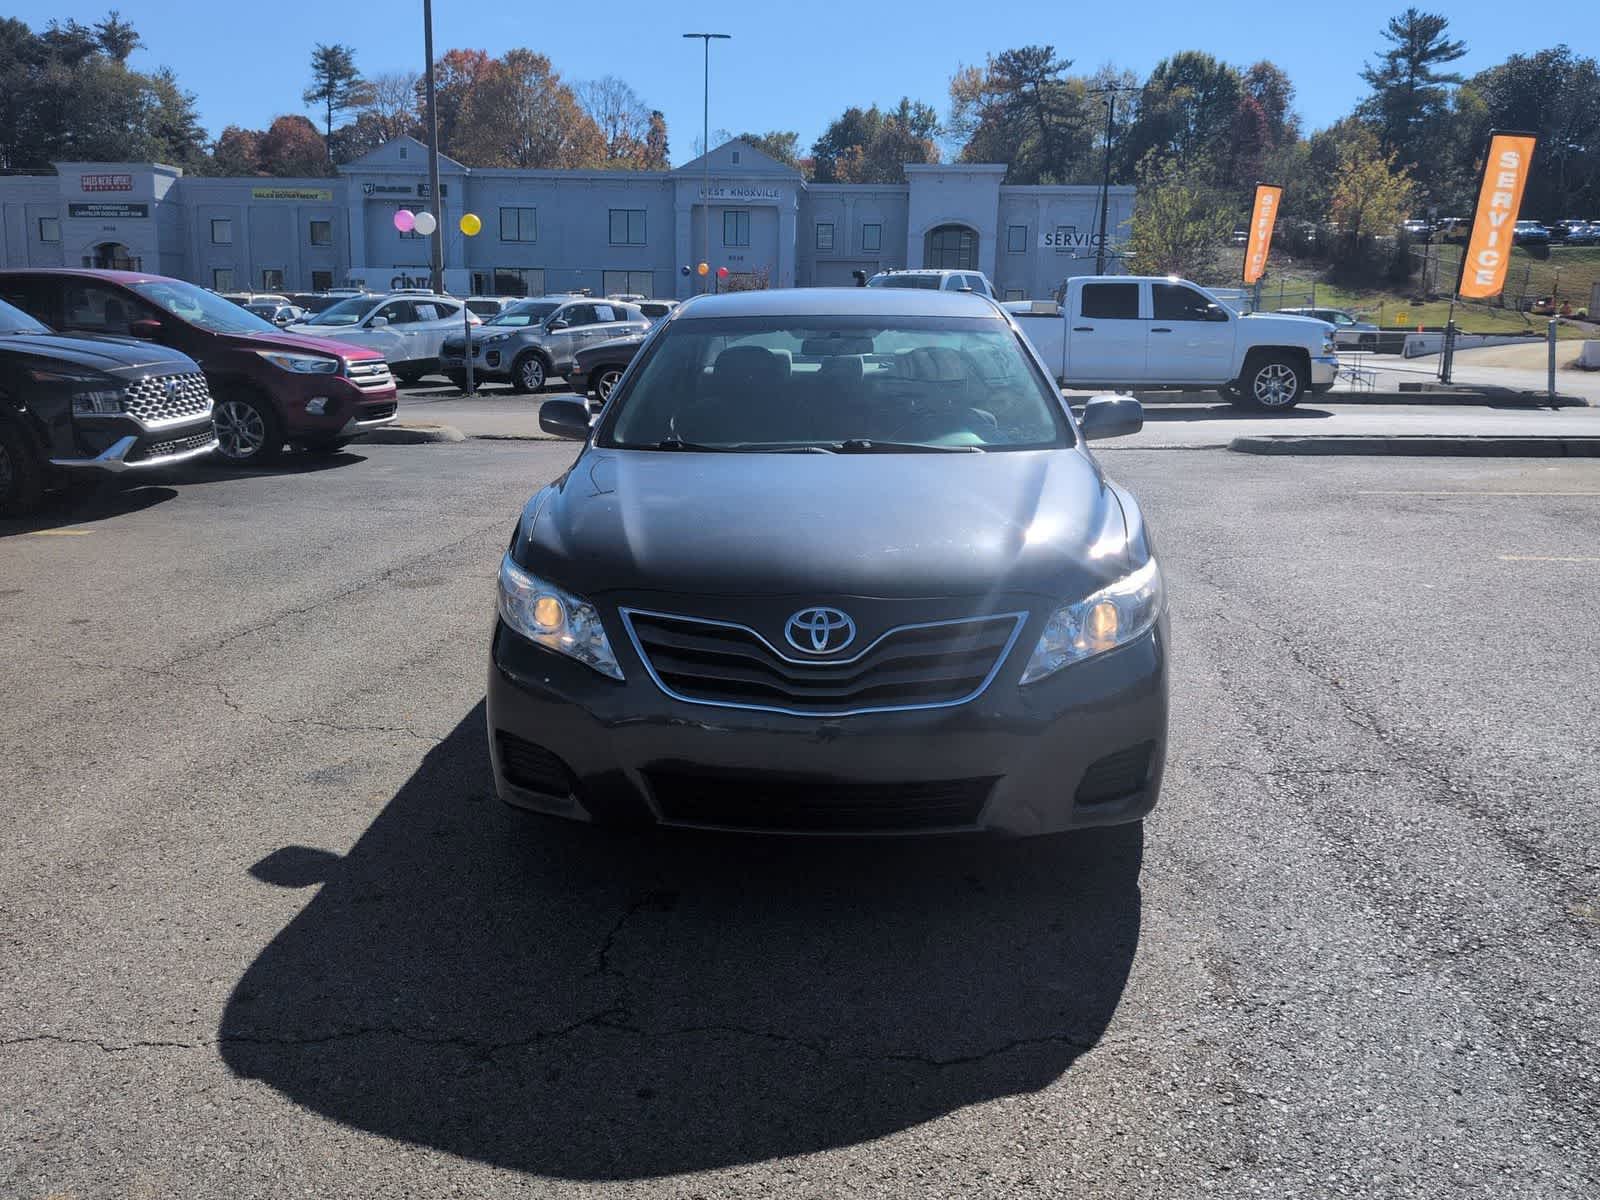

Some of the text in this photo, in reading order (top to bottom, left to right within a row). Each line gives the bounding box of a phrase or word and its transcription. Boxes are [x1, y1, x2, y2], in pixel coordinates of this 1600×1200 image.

[731, 188, 780, 198] KNOXVILLE
[1044, 233, 1110, 246] SERVICE
[1250, 194, 1273, 276] SERVICE
[1475, 151, 1520, 286] SERVICE
